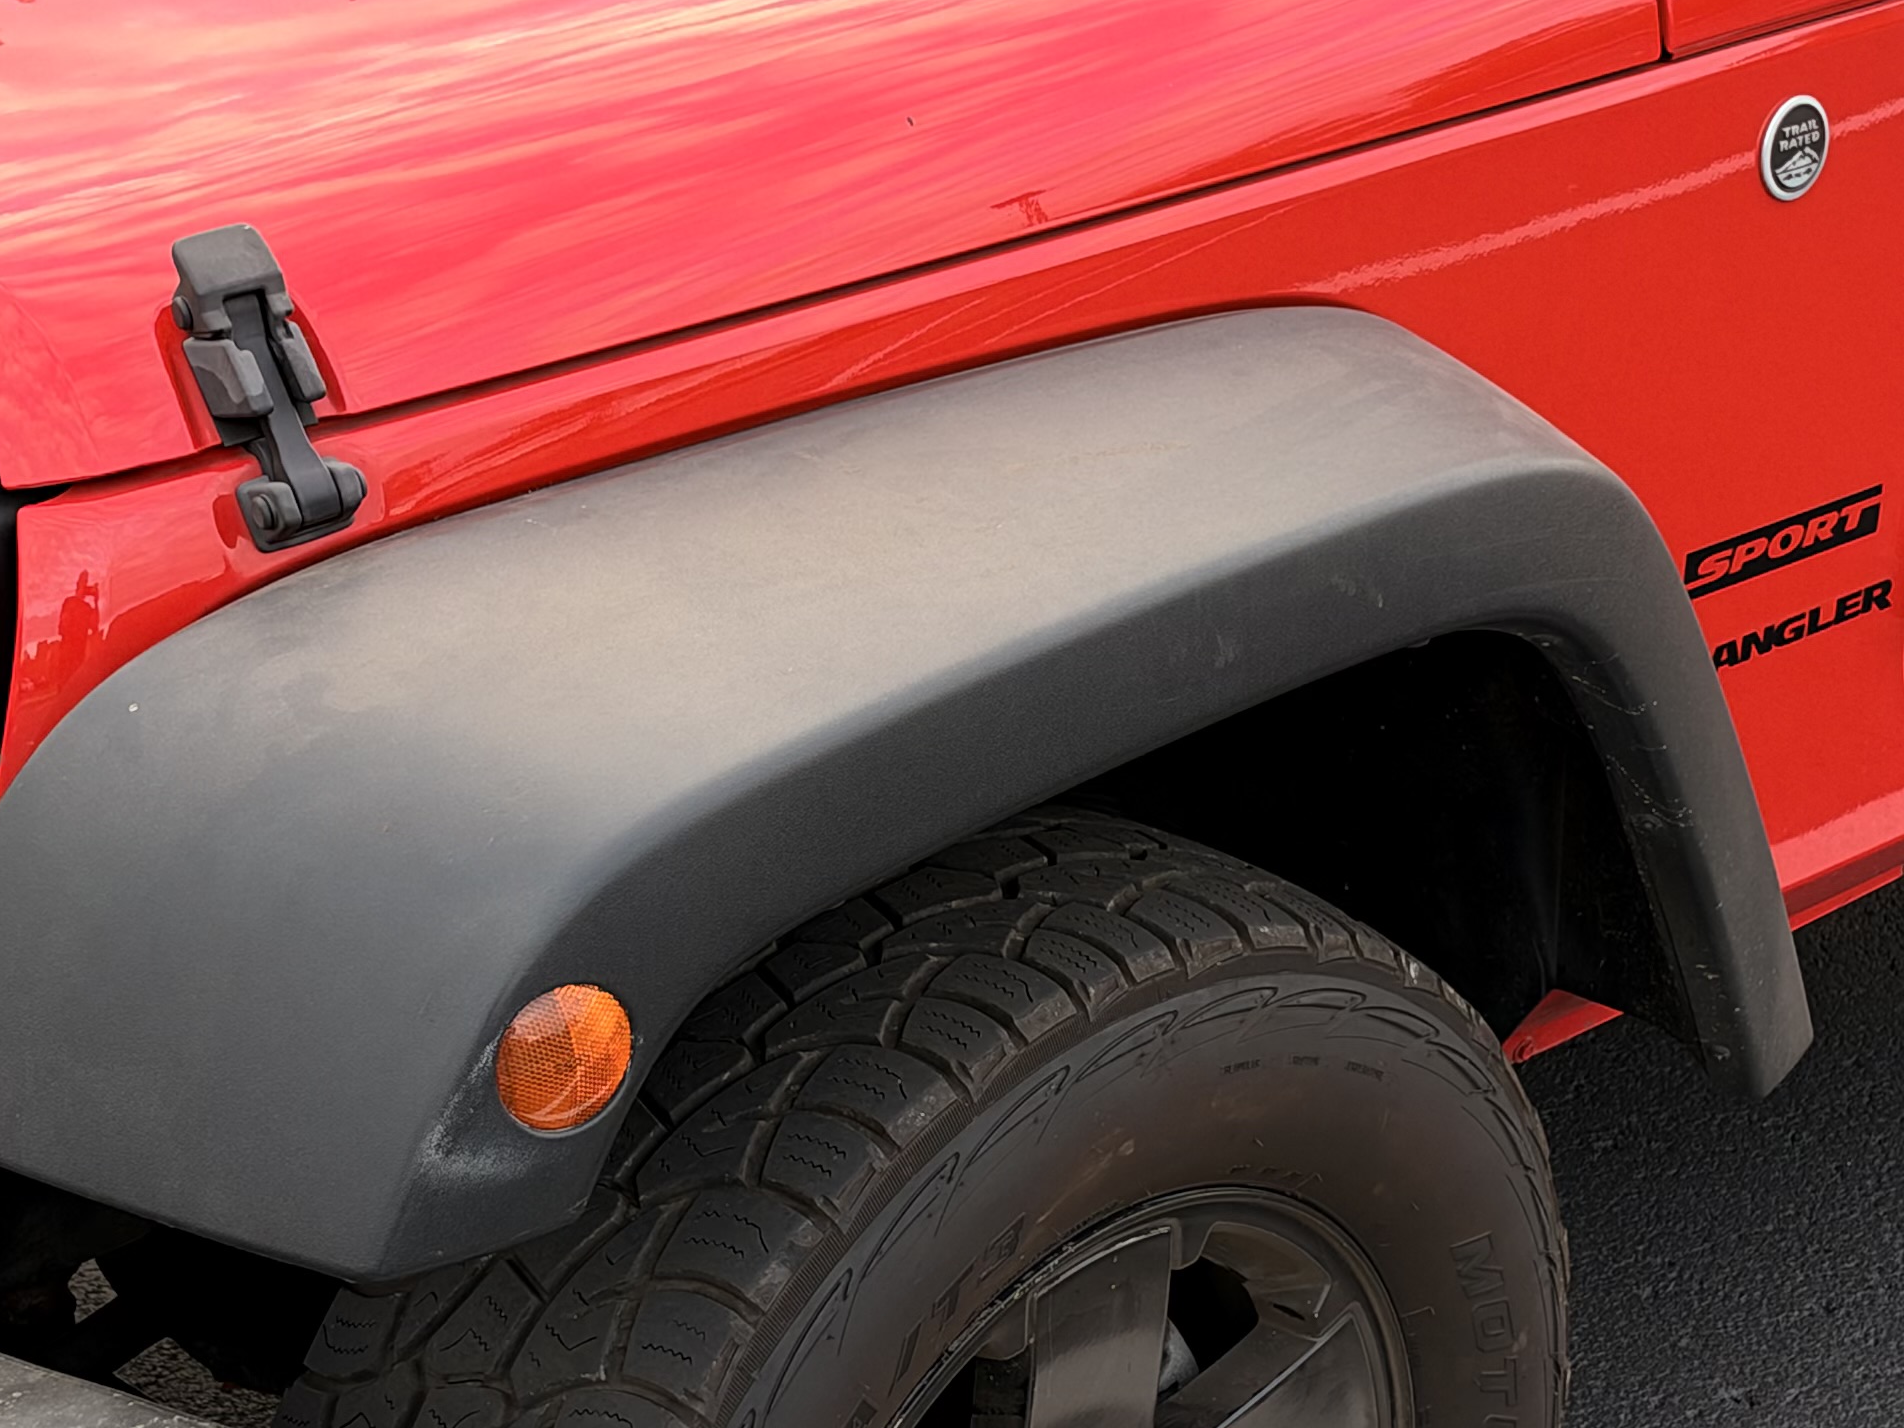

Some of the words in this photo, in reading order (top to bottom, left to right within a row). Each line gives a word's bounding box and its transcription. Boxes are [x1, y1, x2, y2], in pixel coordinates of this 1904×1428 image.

[1781, 118, 1820, 139] TRAIL
[1779, 130, 1821, 153] RATED
[1686, 490, 1883, 594] SPORT
